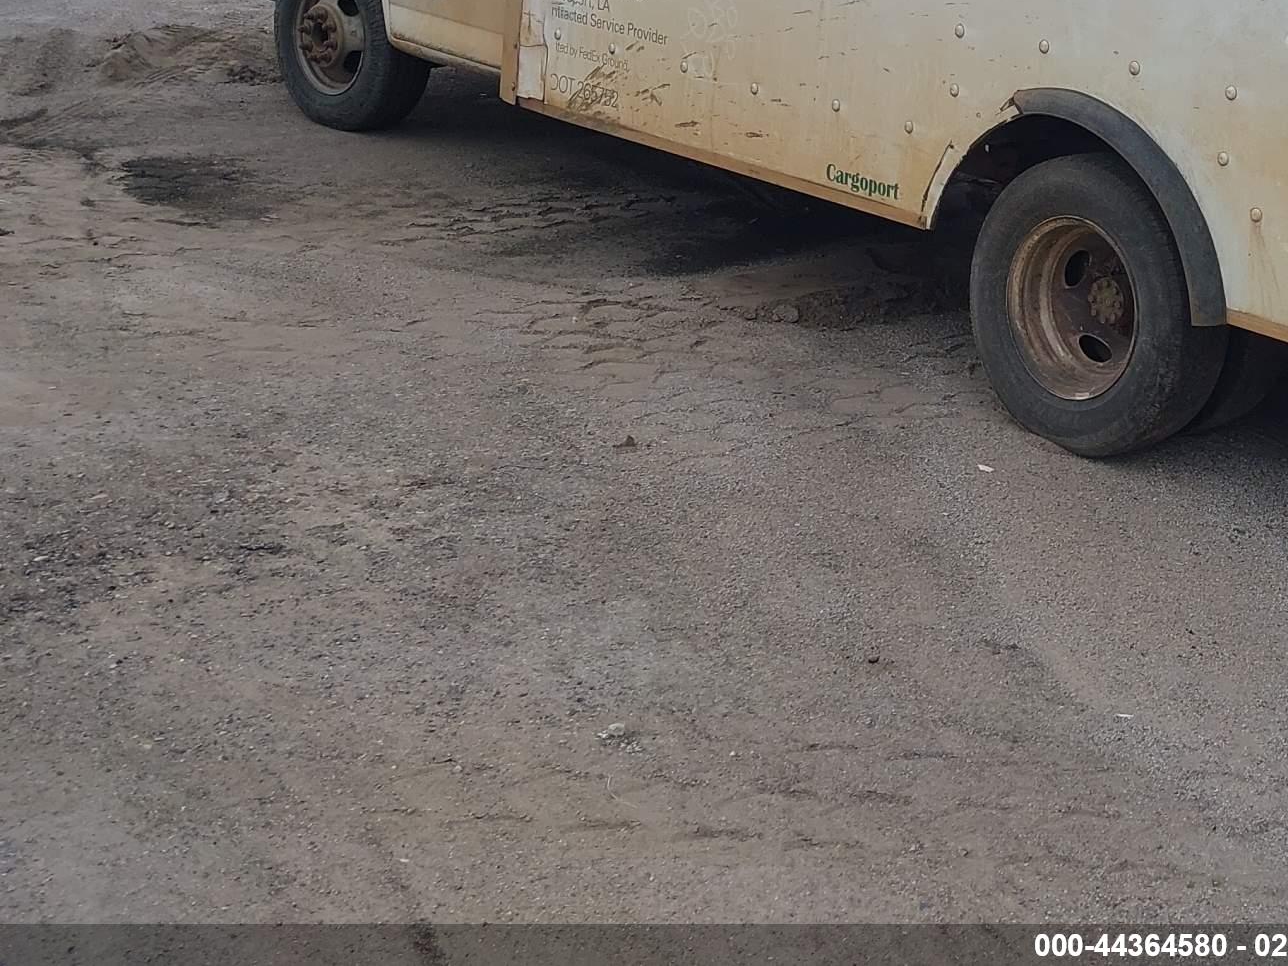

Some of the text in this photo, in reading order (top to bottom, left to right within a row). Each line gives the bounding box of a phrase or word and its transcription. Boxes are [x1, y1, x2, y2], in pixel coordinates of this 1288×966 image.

[590, 13, 625, 35] Service
[627, 22, 668, 46] Provider
[826, 163, 900, 200] Cargoport
